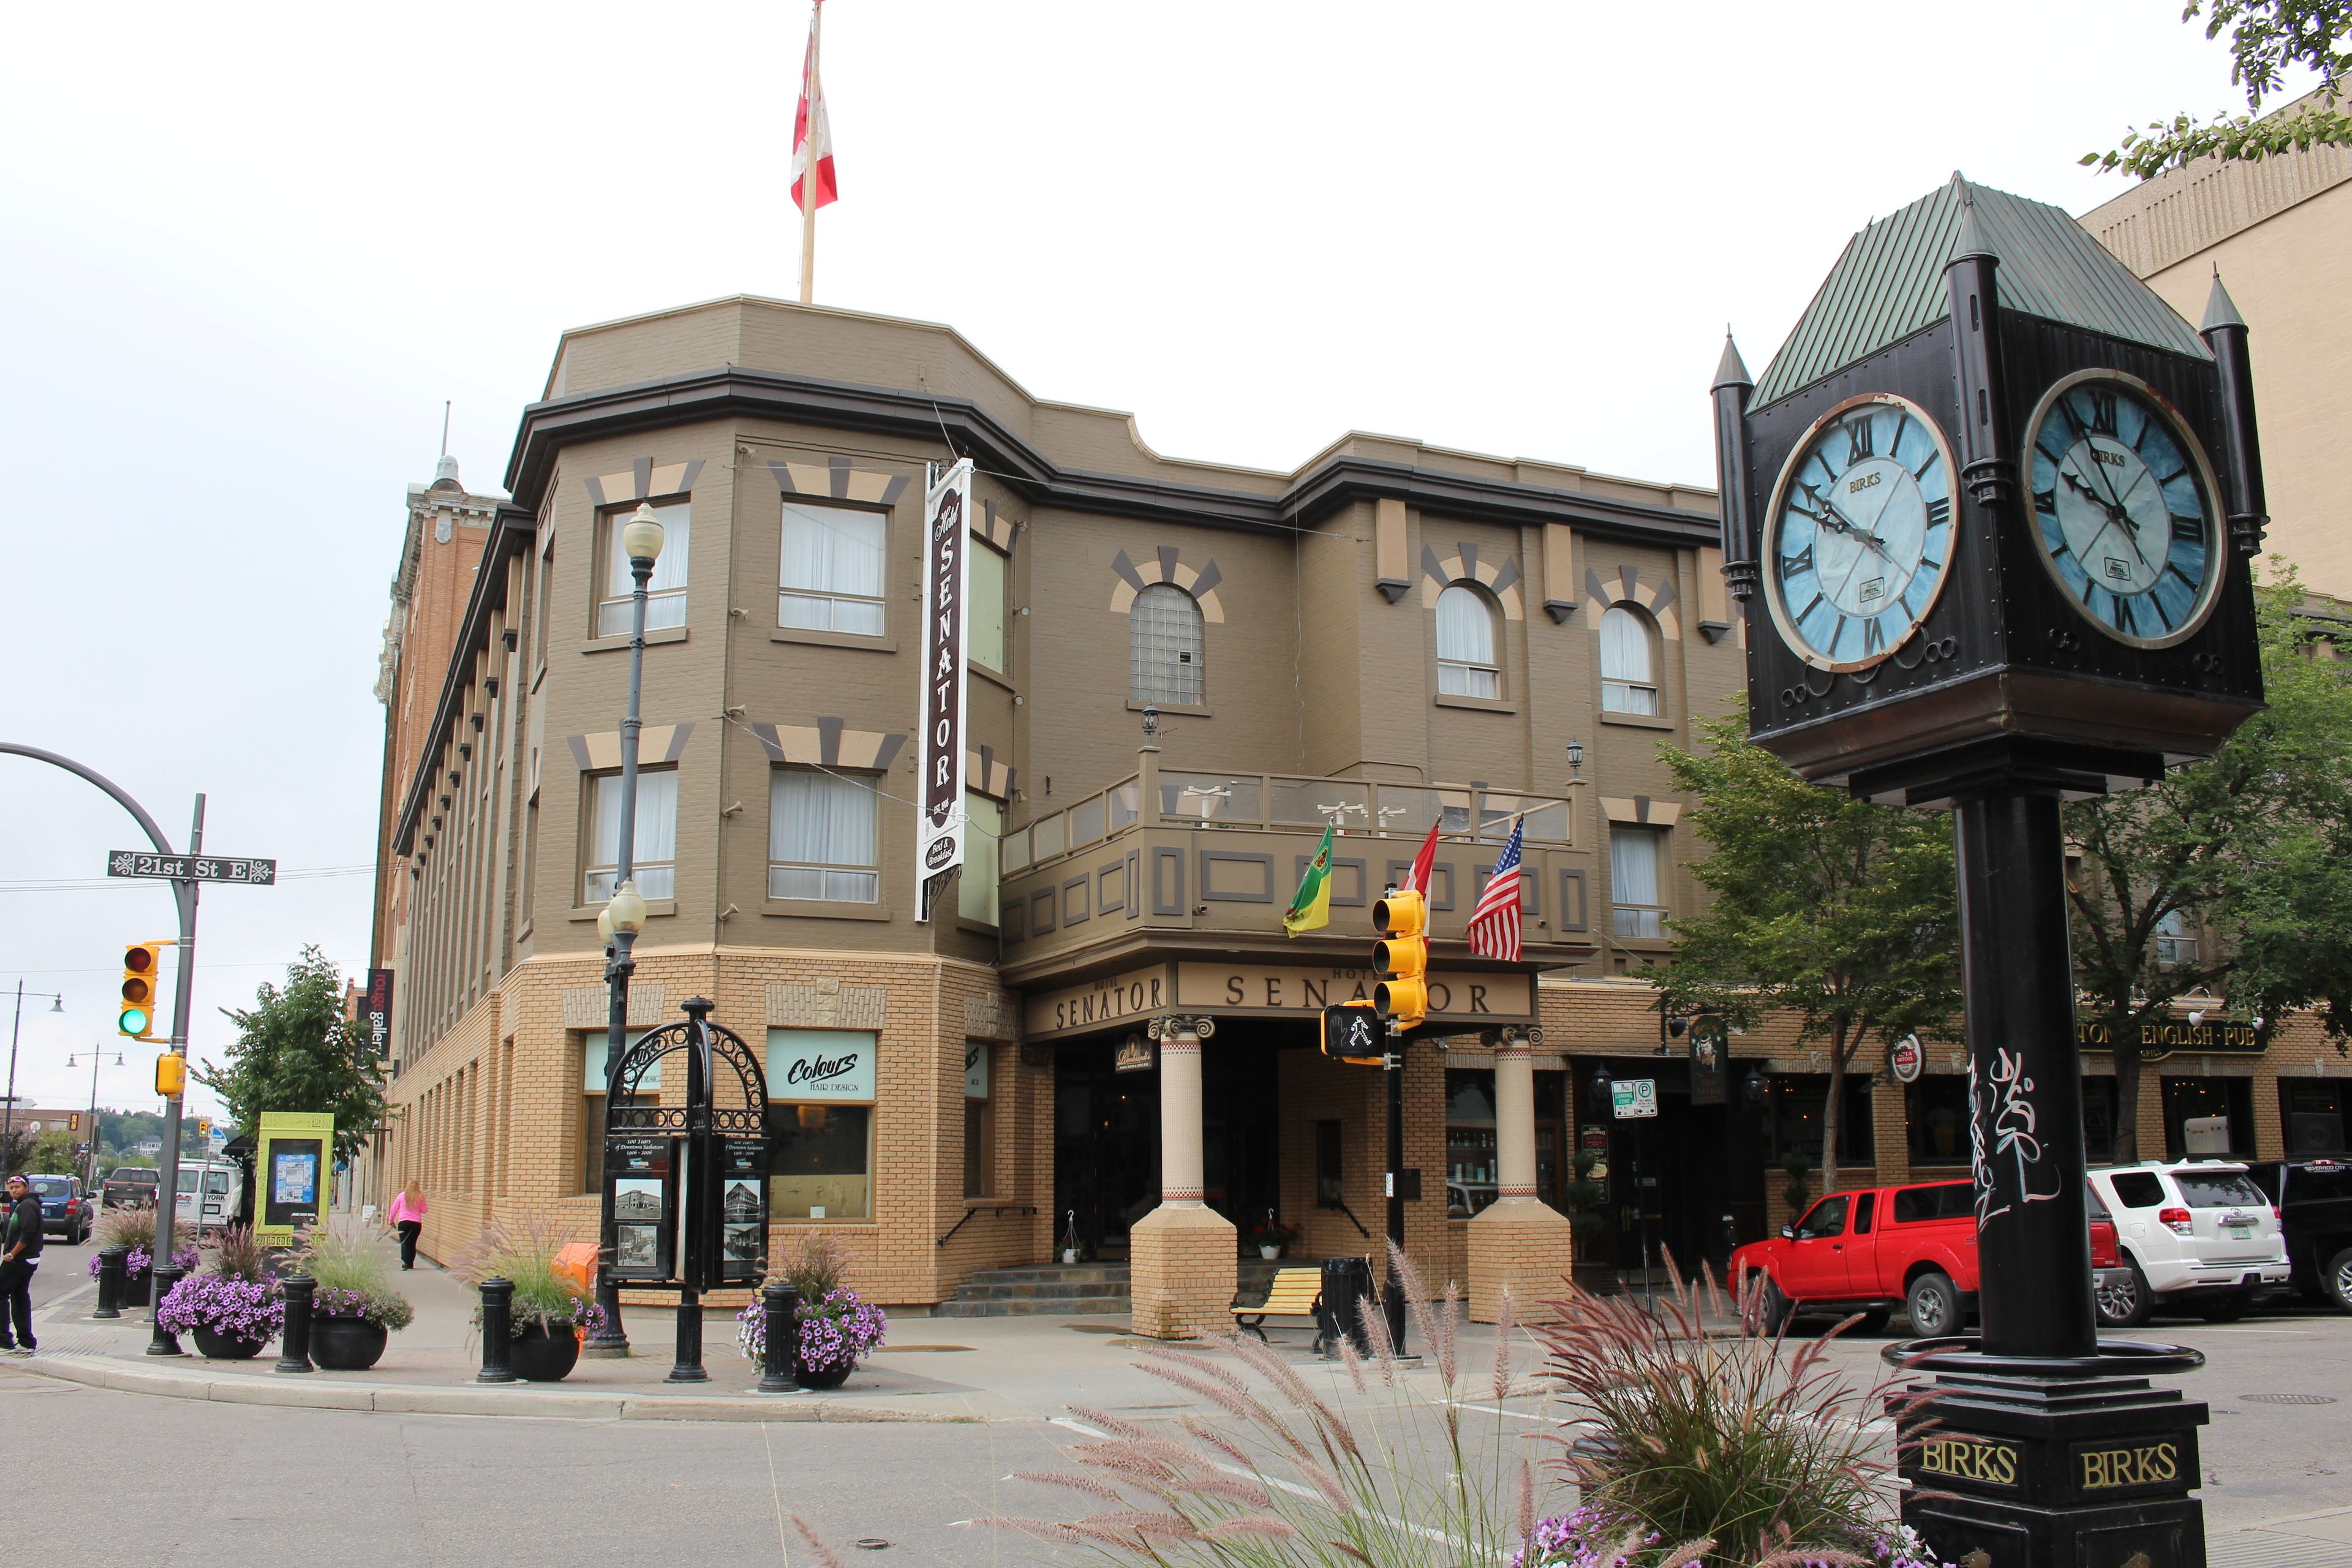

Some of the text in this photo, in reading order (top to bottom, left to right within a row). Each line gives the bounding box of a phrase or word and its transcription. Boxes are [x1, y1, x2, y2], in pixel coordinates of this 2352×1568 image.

[2092, 450, 2125, 467] IRKS
[1849, 472, 1881, 493] BIRKS
[935, 502, 960, 541] Hotel
[935, 537, 953, 788] SENATOR
[929, 847, 952, 867] Breakfast
[932, 838, 949, 855] Bed &
[137, 856, 247, 879] 21st St E
[1094, 977, 1118, 991] HOTEL
[1226, 975, 1490, 1013] SENAOR
[1057, 978, 1161, 1029] SENATOR
[2141, 1025, 2214, 1045] ENGLISH
[2223, 1027, 2256, 1046] PUB
[2140, 1048, 2162, 1057] GRILL
[788, 1054, 858, 1084] Colours
[810, 1083, 829, 1091] HAIR
[1920, 1436, 2018, 1483] BIRKS
[2081, 1442, 2177, 1488] BIRKS
